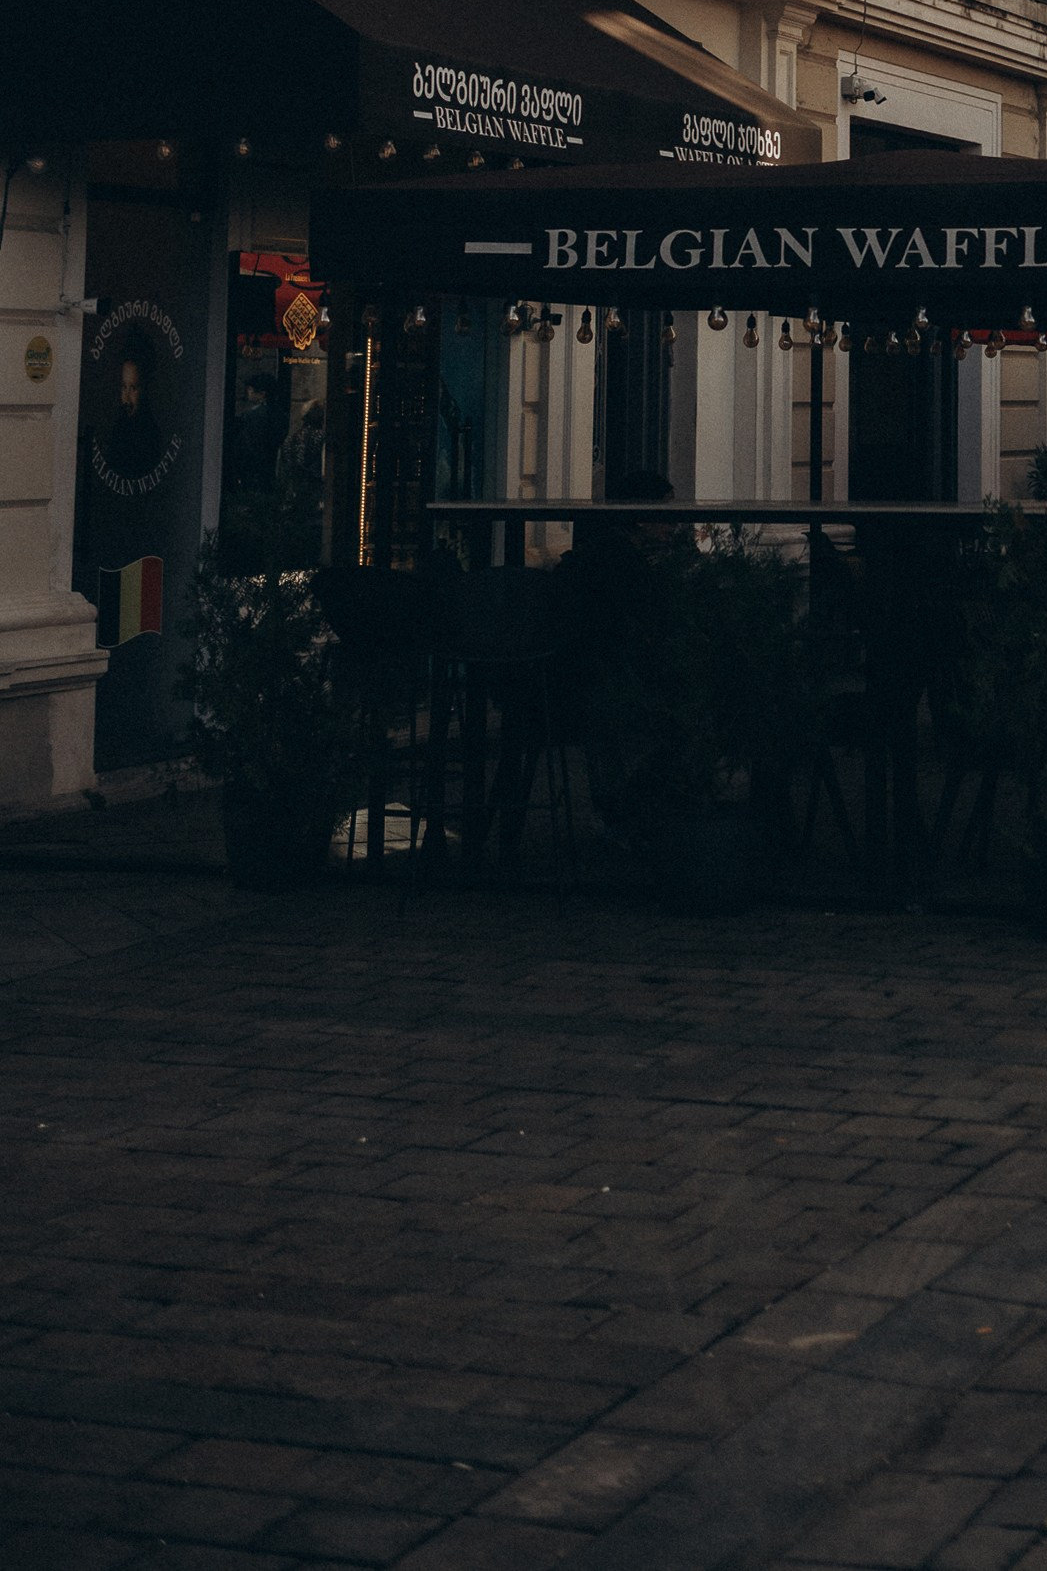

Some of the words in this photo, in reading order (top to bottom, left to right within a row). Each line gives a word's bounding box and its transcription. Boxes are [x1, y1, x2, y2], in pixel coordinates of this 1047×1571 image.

[413, 62, 517, 115] ბელგიური
[520, 84, 582, 126] ვაფლი
[434, 105, 506, 139] BELGIAN
[507, 118, 567, 149] WAFFLE
[683, 113, 735, 150] ვაფლი
[738, 123, 781, 159] ჯოხზე
[543, 227, 817, 270] BELGIAN
[150, 303, 184, 360] ვაფლი
